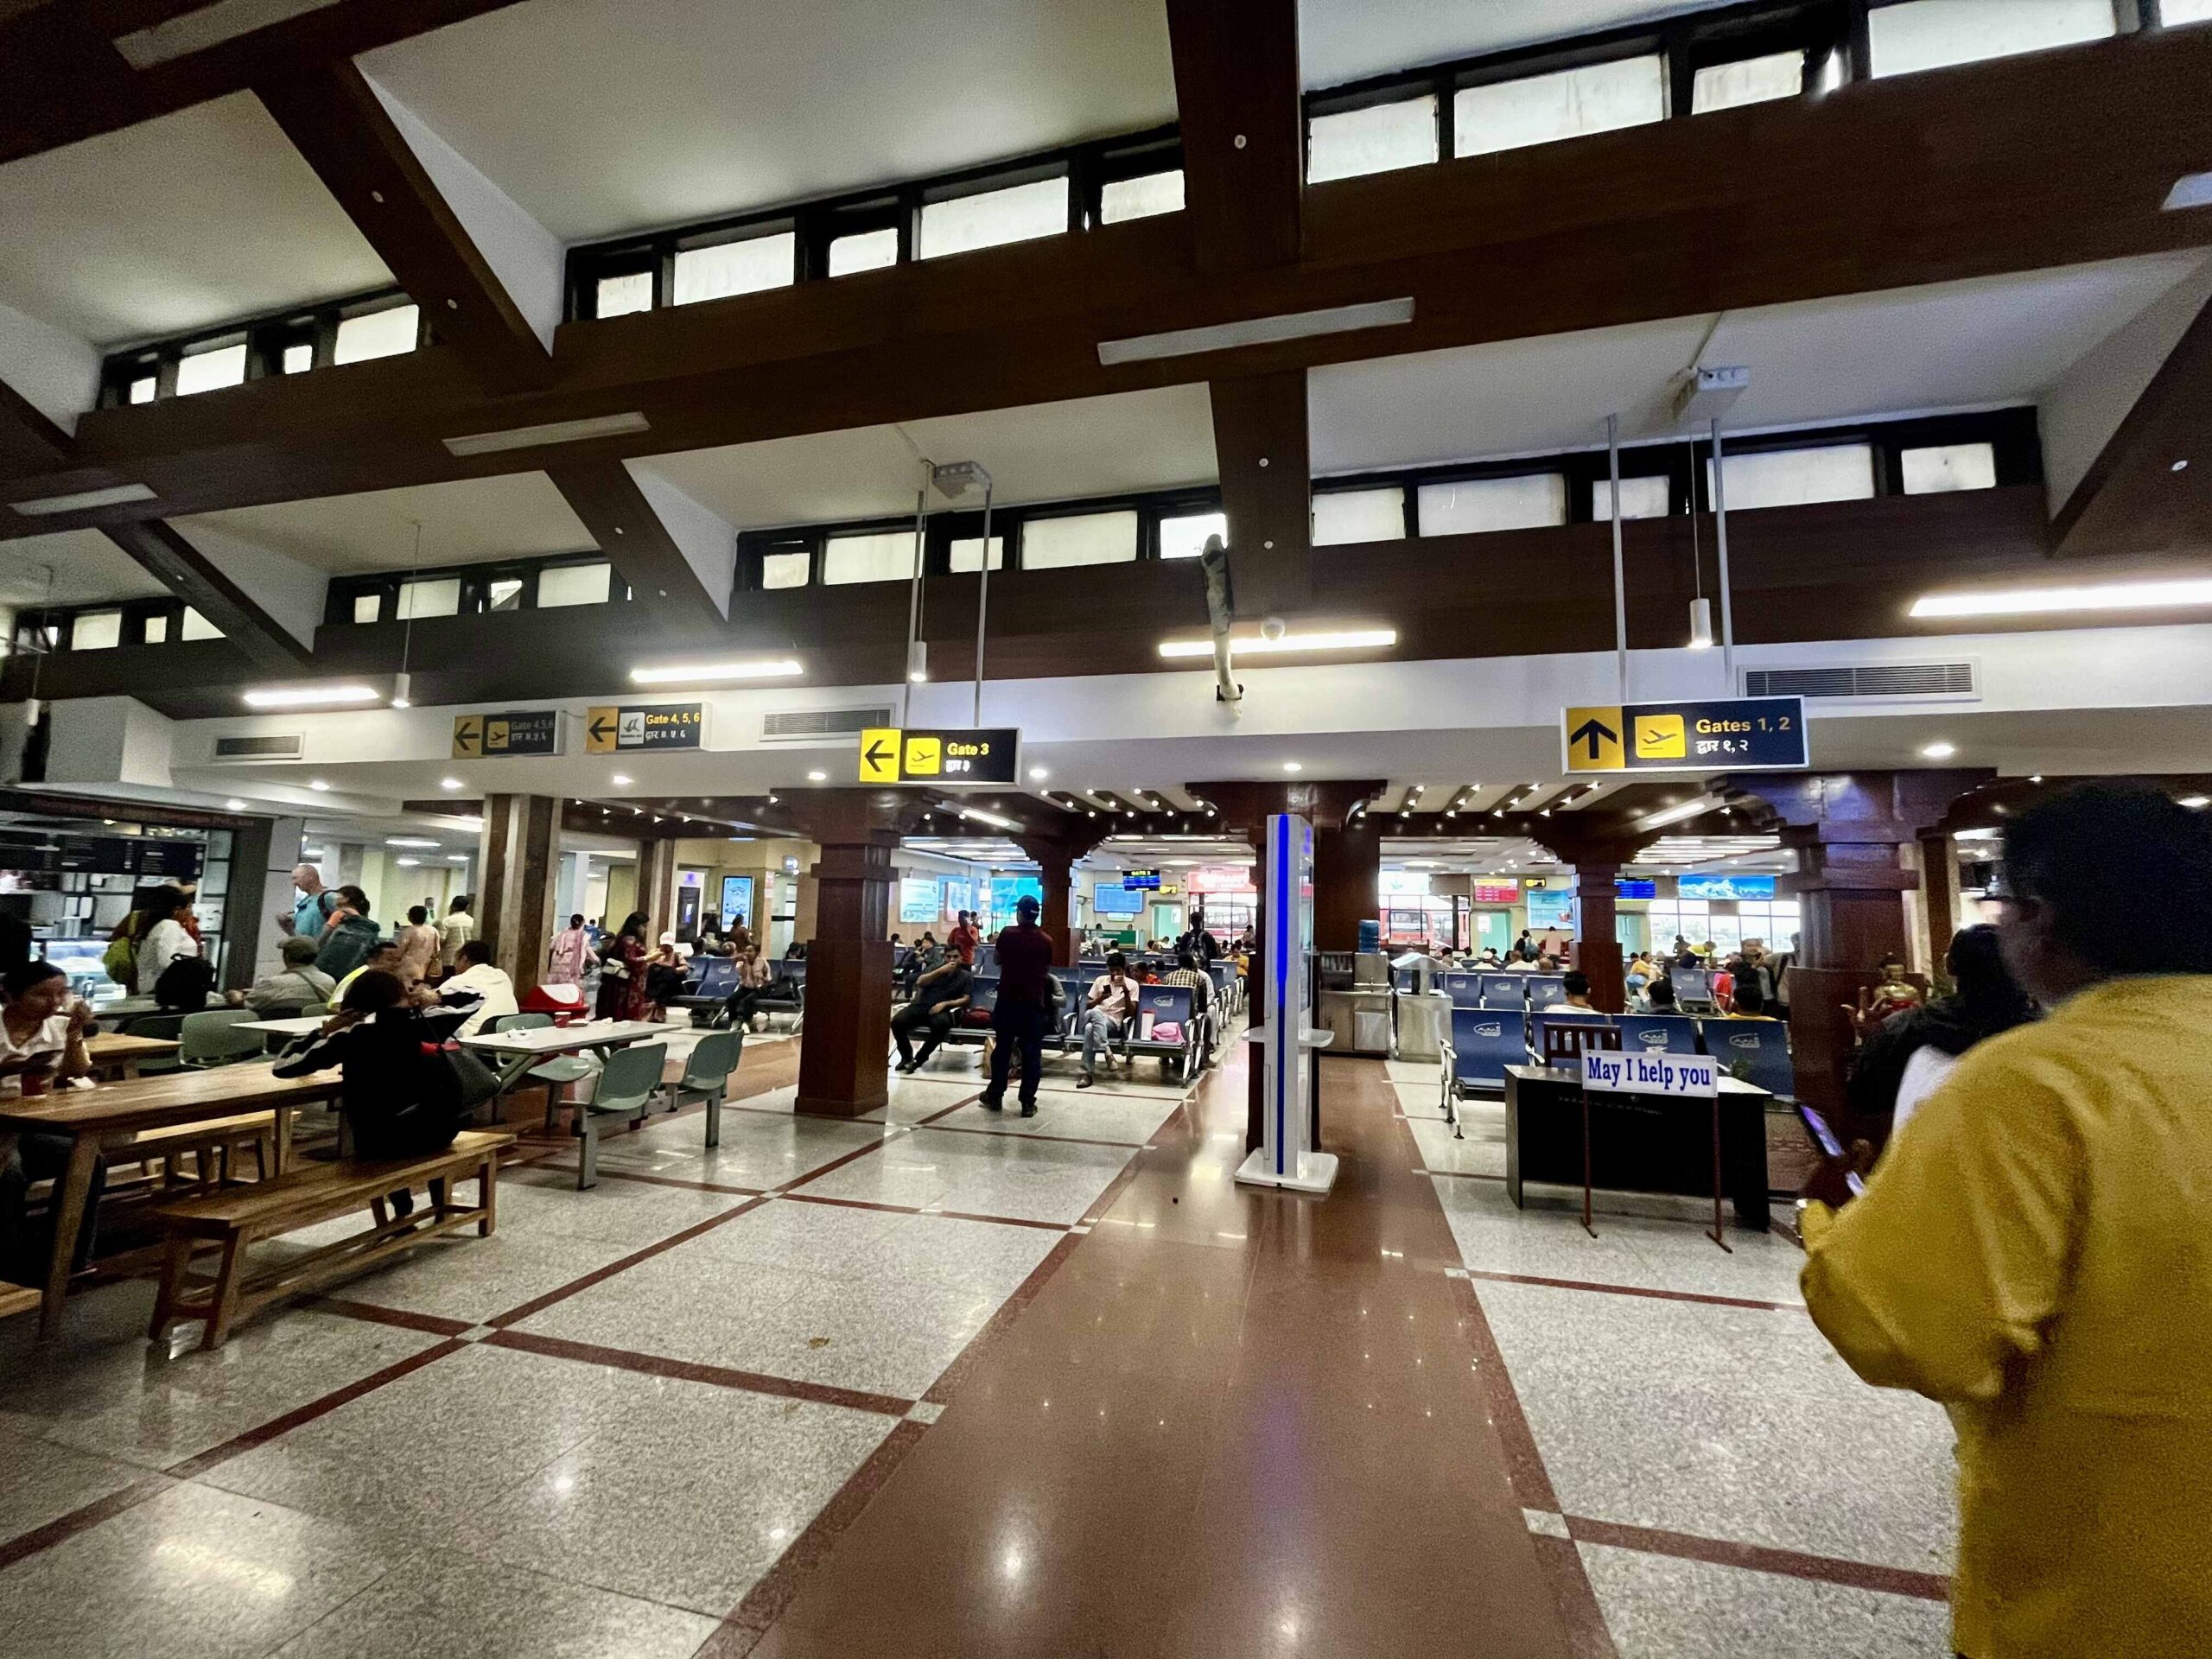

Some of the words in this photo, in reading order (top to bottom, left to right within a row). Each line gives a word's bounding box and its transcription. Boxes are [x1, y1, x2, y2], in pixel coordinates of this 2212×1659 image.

[645, 714, 669, 725] Gate
[671, 713, 680, 725] 4,
[682, 712, 691, 725] 5,
[693, 712, 701, 722] 6
[1695, 718, 1751, 734] Gates
[1757, 717, 1773, 733] 1,
[1778, 716, 1791, 730] 2
[947, 742, 978, 756] Gate
[980, 742, 989, 756] 3
[1695, 739, 1719, 755] द्वार
[1722, 740, 1736, 753] १,
[1738, 739, 1749, 751] २
[1587, 1056, 1621, 1088] May
[1626, 1058, 1632, 1081] I
[1638, 1058, 1674, 1090] help
[1679, 1066, 1711, 1091] you
